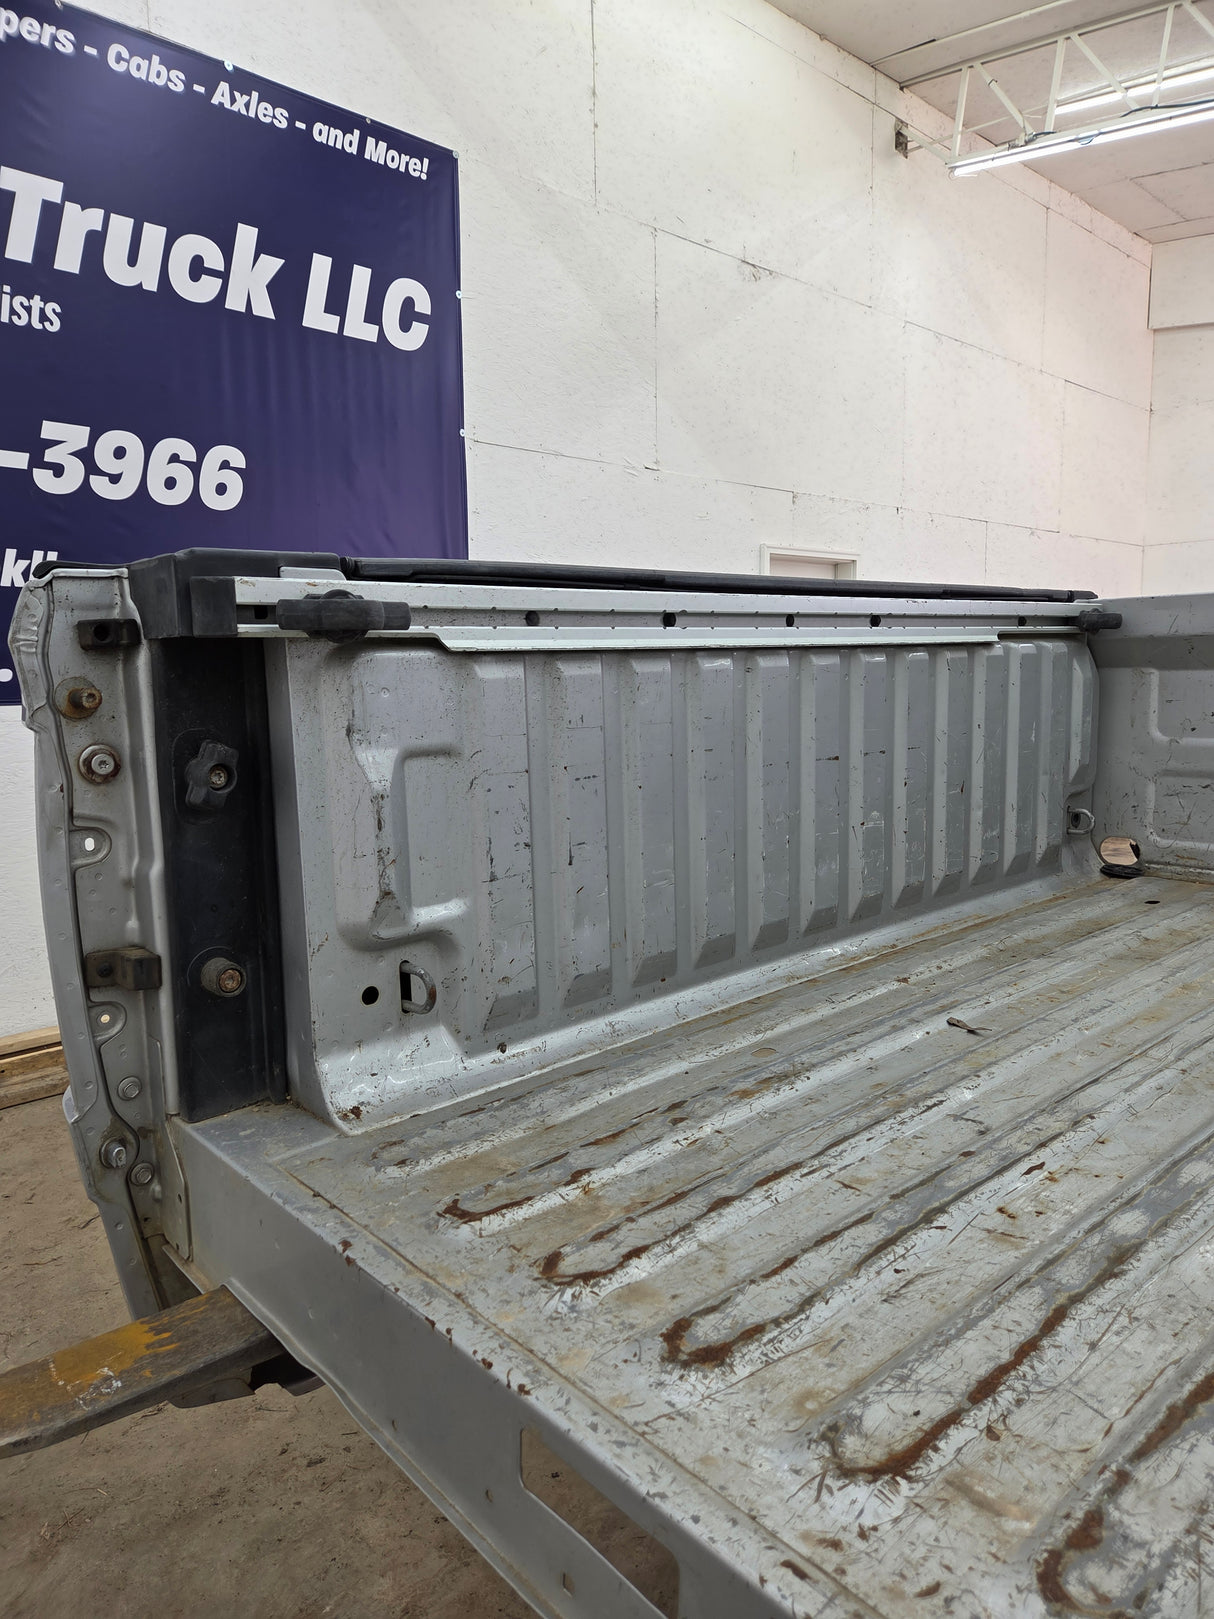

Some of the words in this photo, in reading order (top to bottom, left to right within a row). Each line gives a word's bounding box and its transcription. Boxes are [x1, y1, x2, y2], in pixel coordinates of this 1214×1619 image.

[107, 43, 186, 93] Cabs
[211, 81, 289, 130] Axles
[312, 122, 360, 156] and
[364, 136, 429, 181] More!
[0, 166, 286, 321] Truck
[302, 252, 432, 352] LLC
[0, 284, 62, 333] ists
